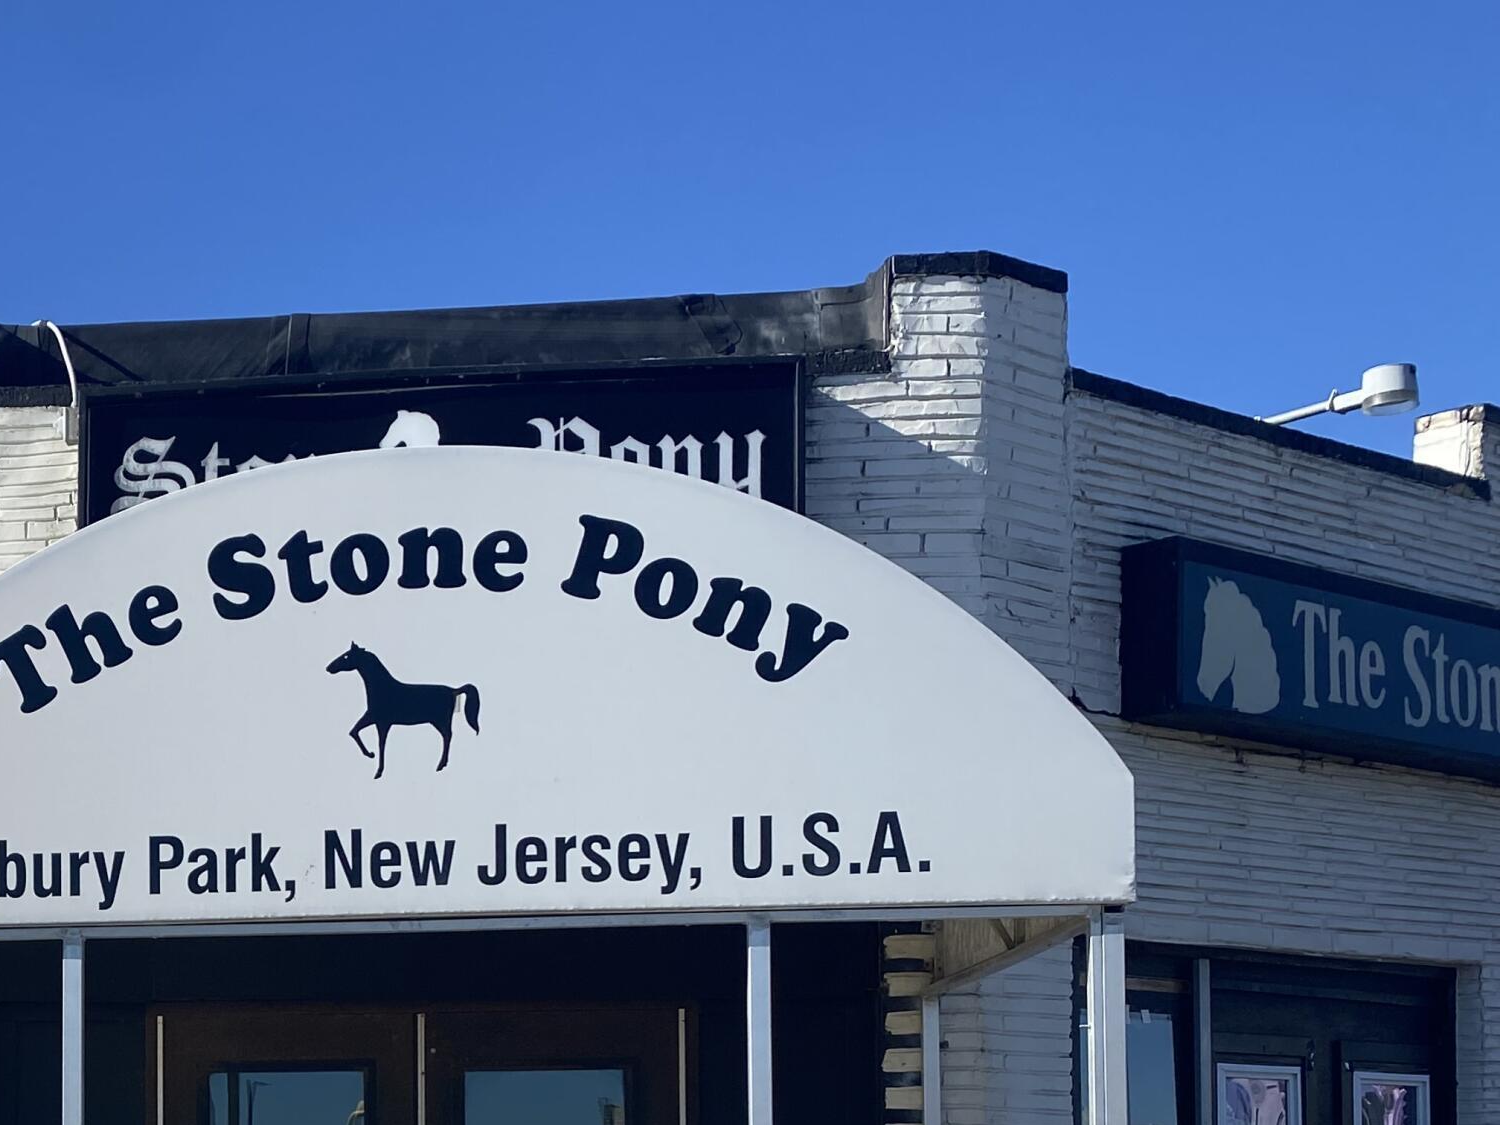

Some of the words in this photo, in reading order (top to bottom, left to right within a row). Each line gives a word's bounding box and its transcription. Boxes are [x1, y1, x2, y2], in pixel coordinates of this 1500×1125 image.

[208, 526, 528, 620] Stone
[561, 514, 849, 682] Pony
[1292, 599, 1386, 709] The
[148, 833, 297, 903] Park,
[323, 829, 457, 890] New
[477, 824, 702, 896] Jersey,
[731, 811, 931, 879] U.S.A.
